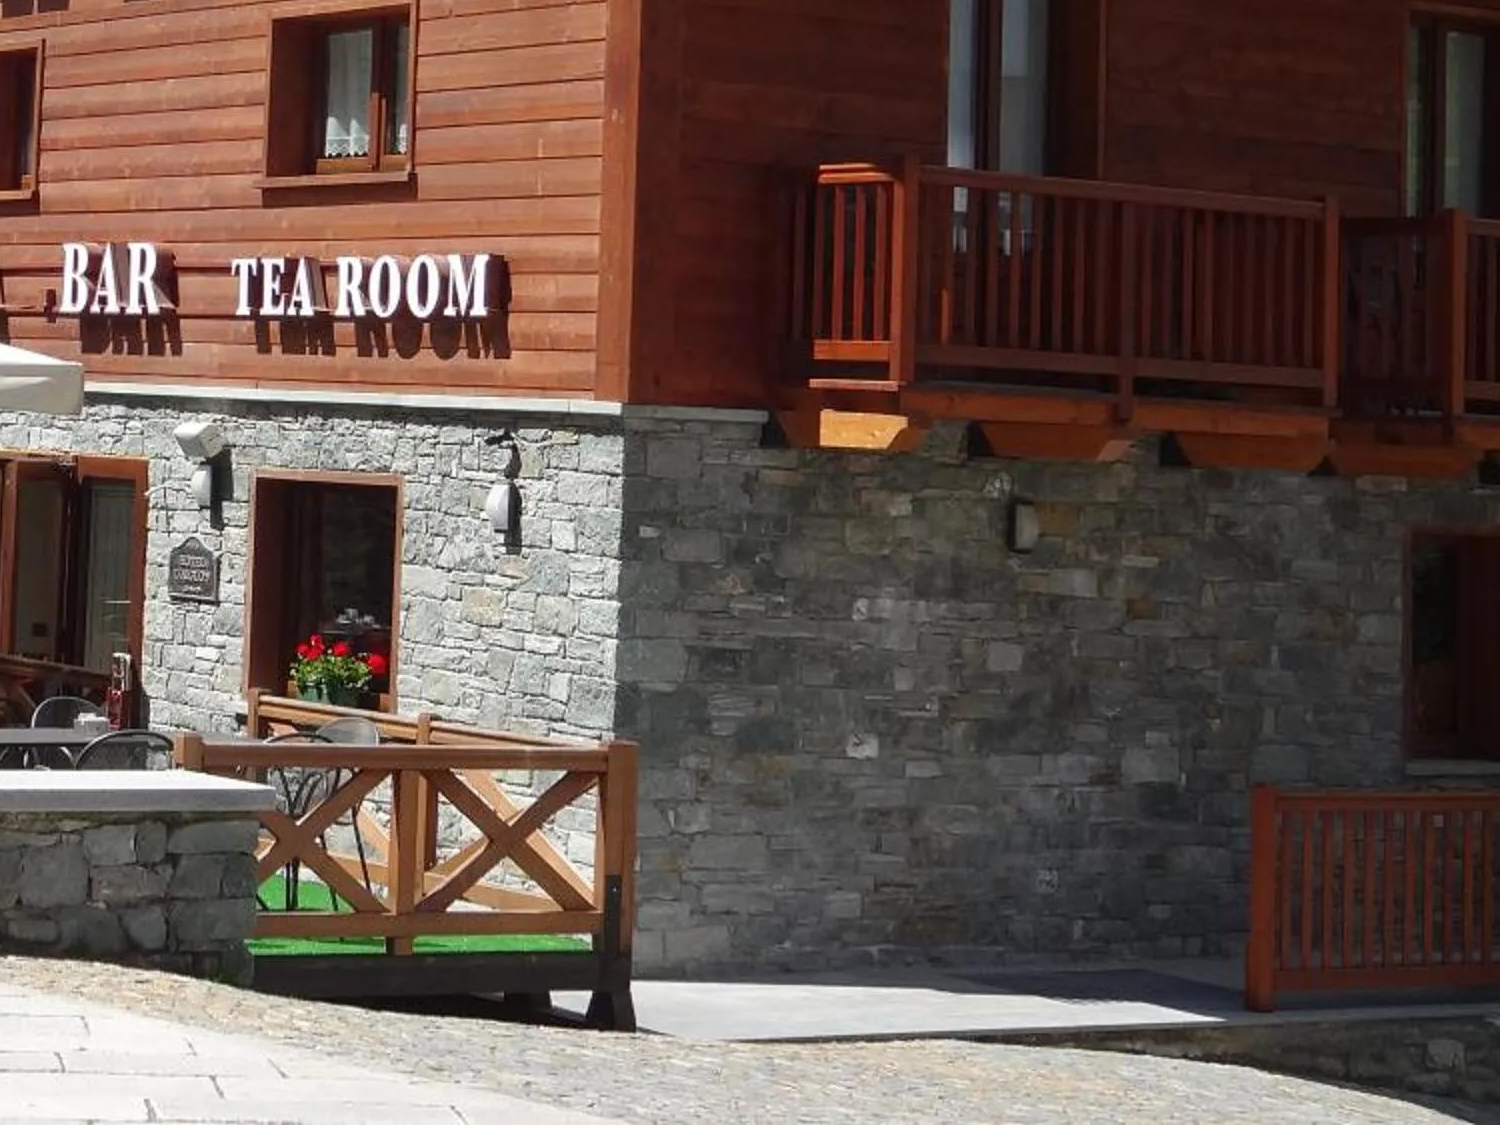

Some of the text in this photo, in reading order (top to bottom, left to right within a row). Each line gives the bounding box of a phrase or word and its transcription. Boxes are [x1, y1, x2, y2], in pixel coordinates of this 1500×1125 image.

[59, 242, 162, 315] BAR
[231, 253, 490, 318] TEA ROOM
